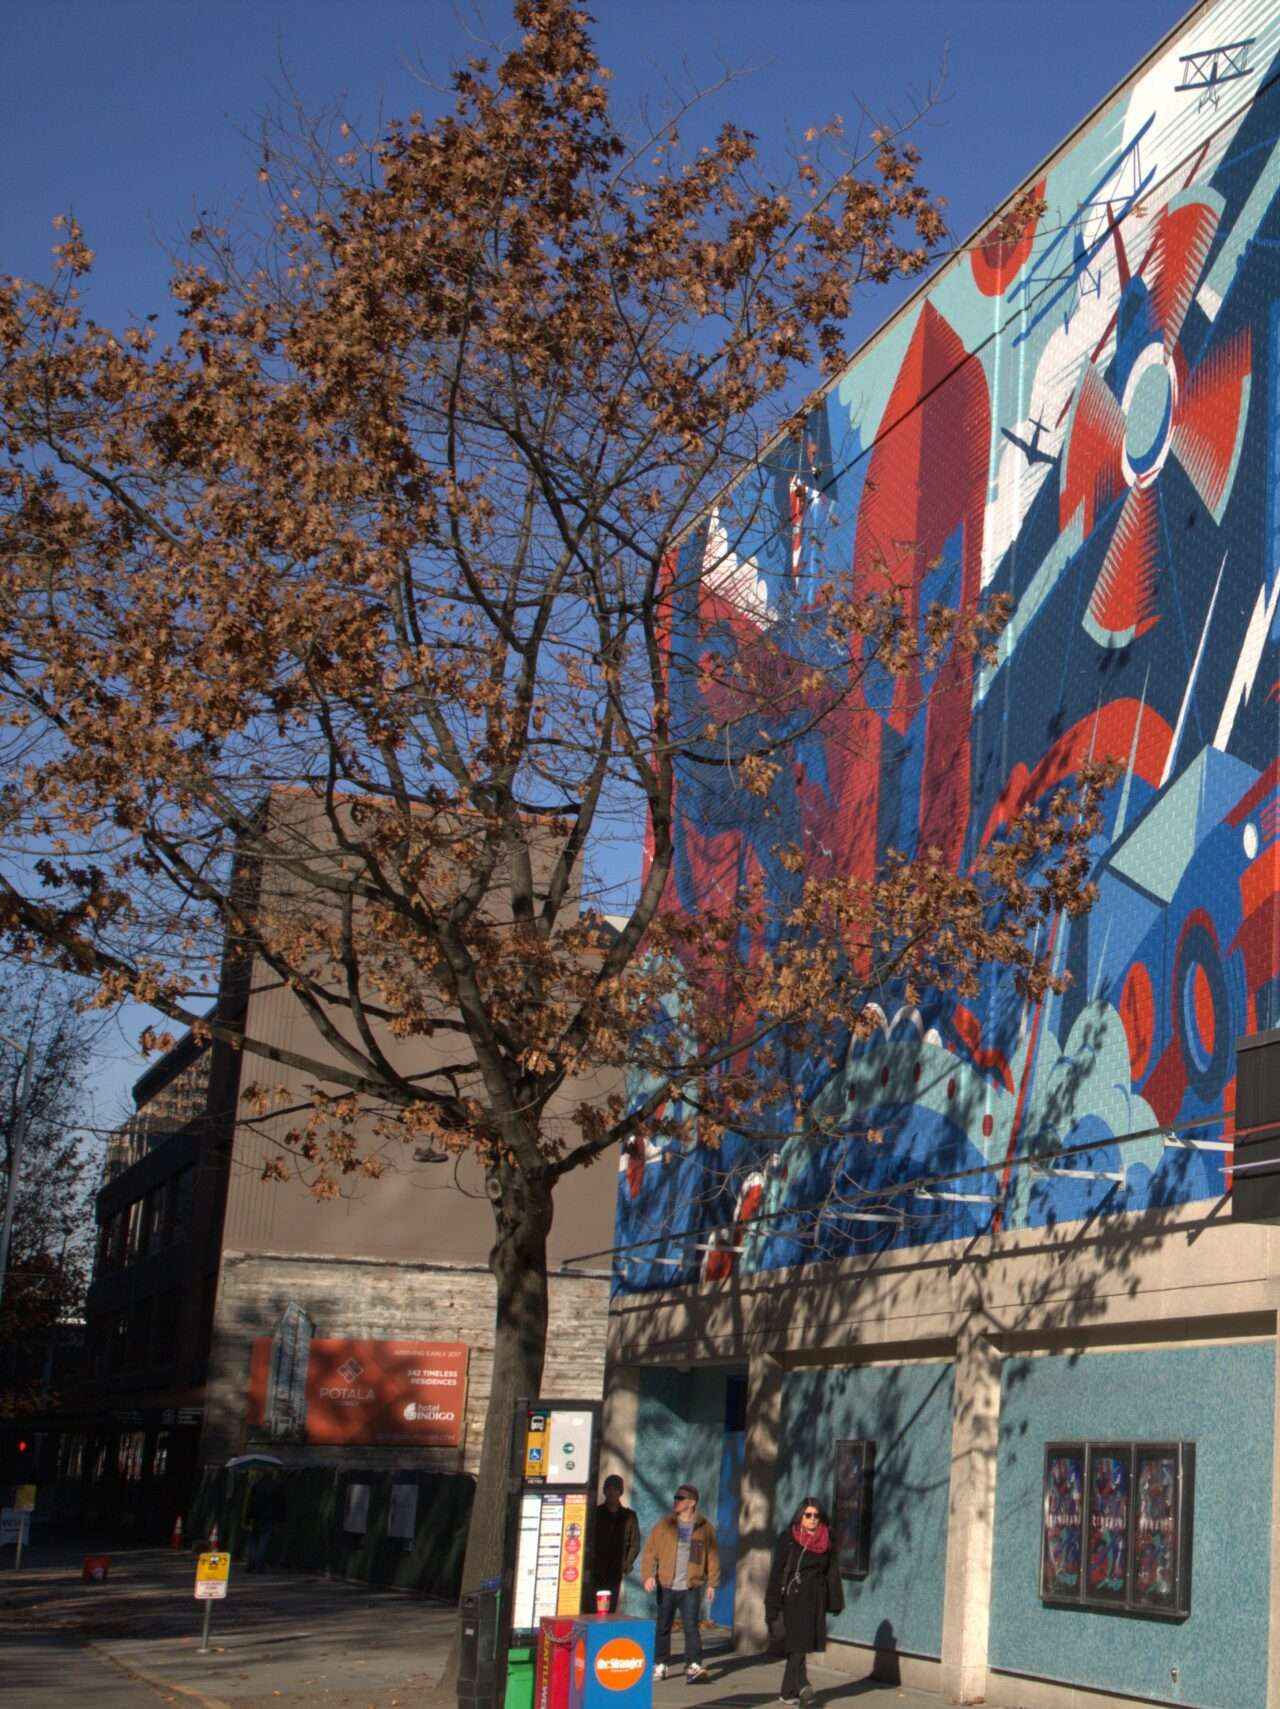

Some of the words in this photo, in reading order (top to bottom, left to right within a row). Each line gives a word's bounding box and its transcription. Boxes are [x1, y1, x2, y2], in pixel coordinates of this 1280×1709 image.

[423, 1369, 458, 1377] TIMELESS
[410, 1377, 457, 1386] RESIDENCES
[319, 1387, 376, 1400] POTALA
[417, 1403, 441, 1412] hotel
[417, 1411, 455, 1421] INDIGO
